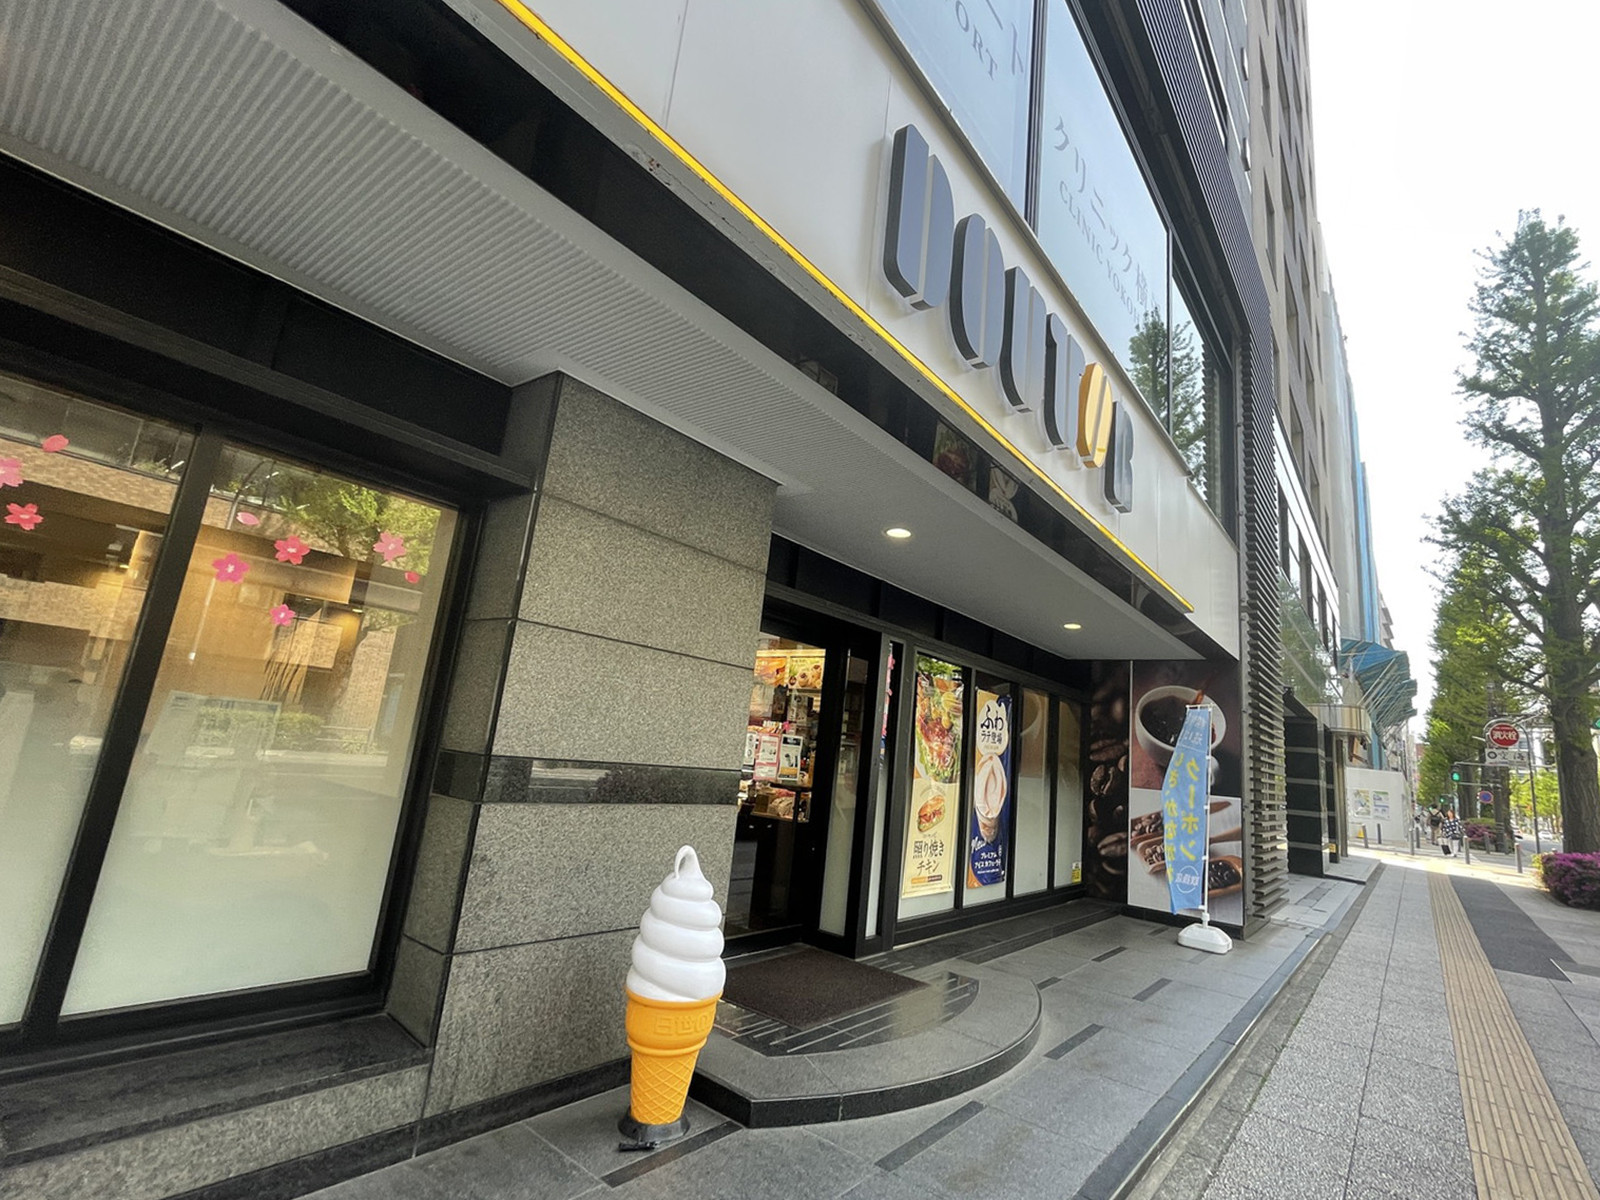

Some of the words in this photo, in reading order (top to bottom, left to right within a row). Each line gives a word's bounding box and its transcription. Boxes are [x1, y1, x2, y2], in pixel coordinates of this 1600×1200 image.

[1059, 180, 1103, 265] CLINIC
[882, 123, 1134, 514] DOUTOR
[980, 704, 1005, 732] ふわ
[1492, 730, 1518, 740] 消火栓
[912, 839, 945, 859] 照り焼き
[916, 858, 940, 876] チキン
